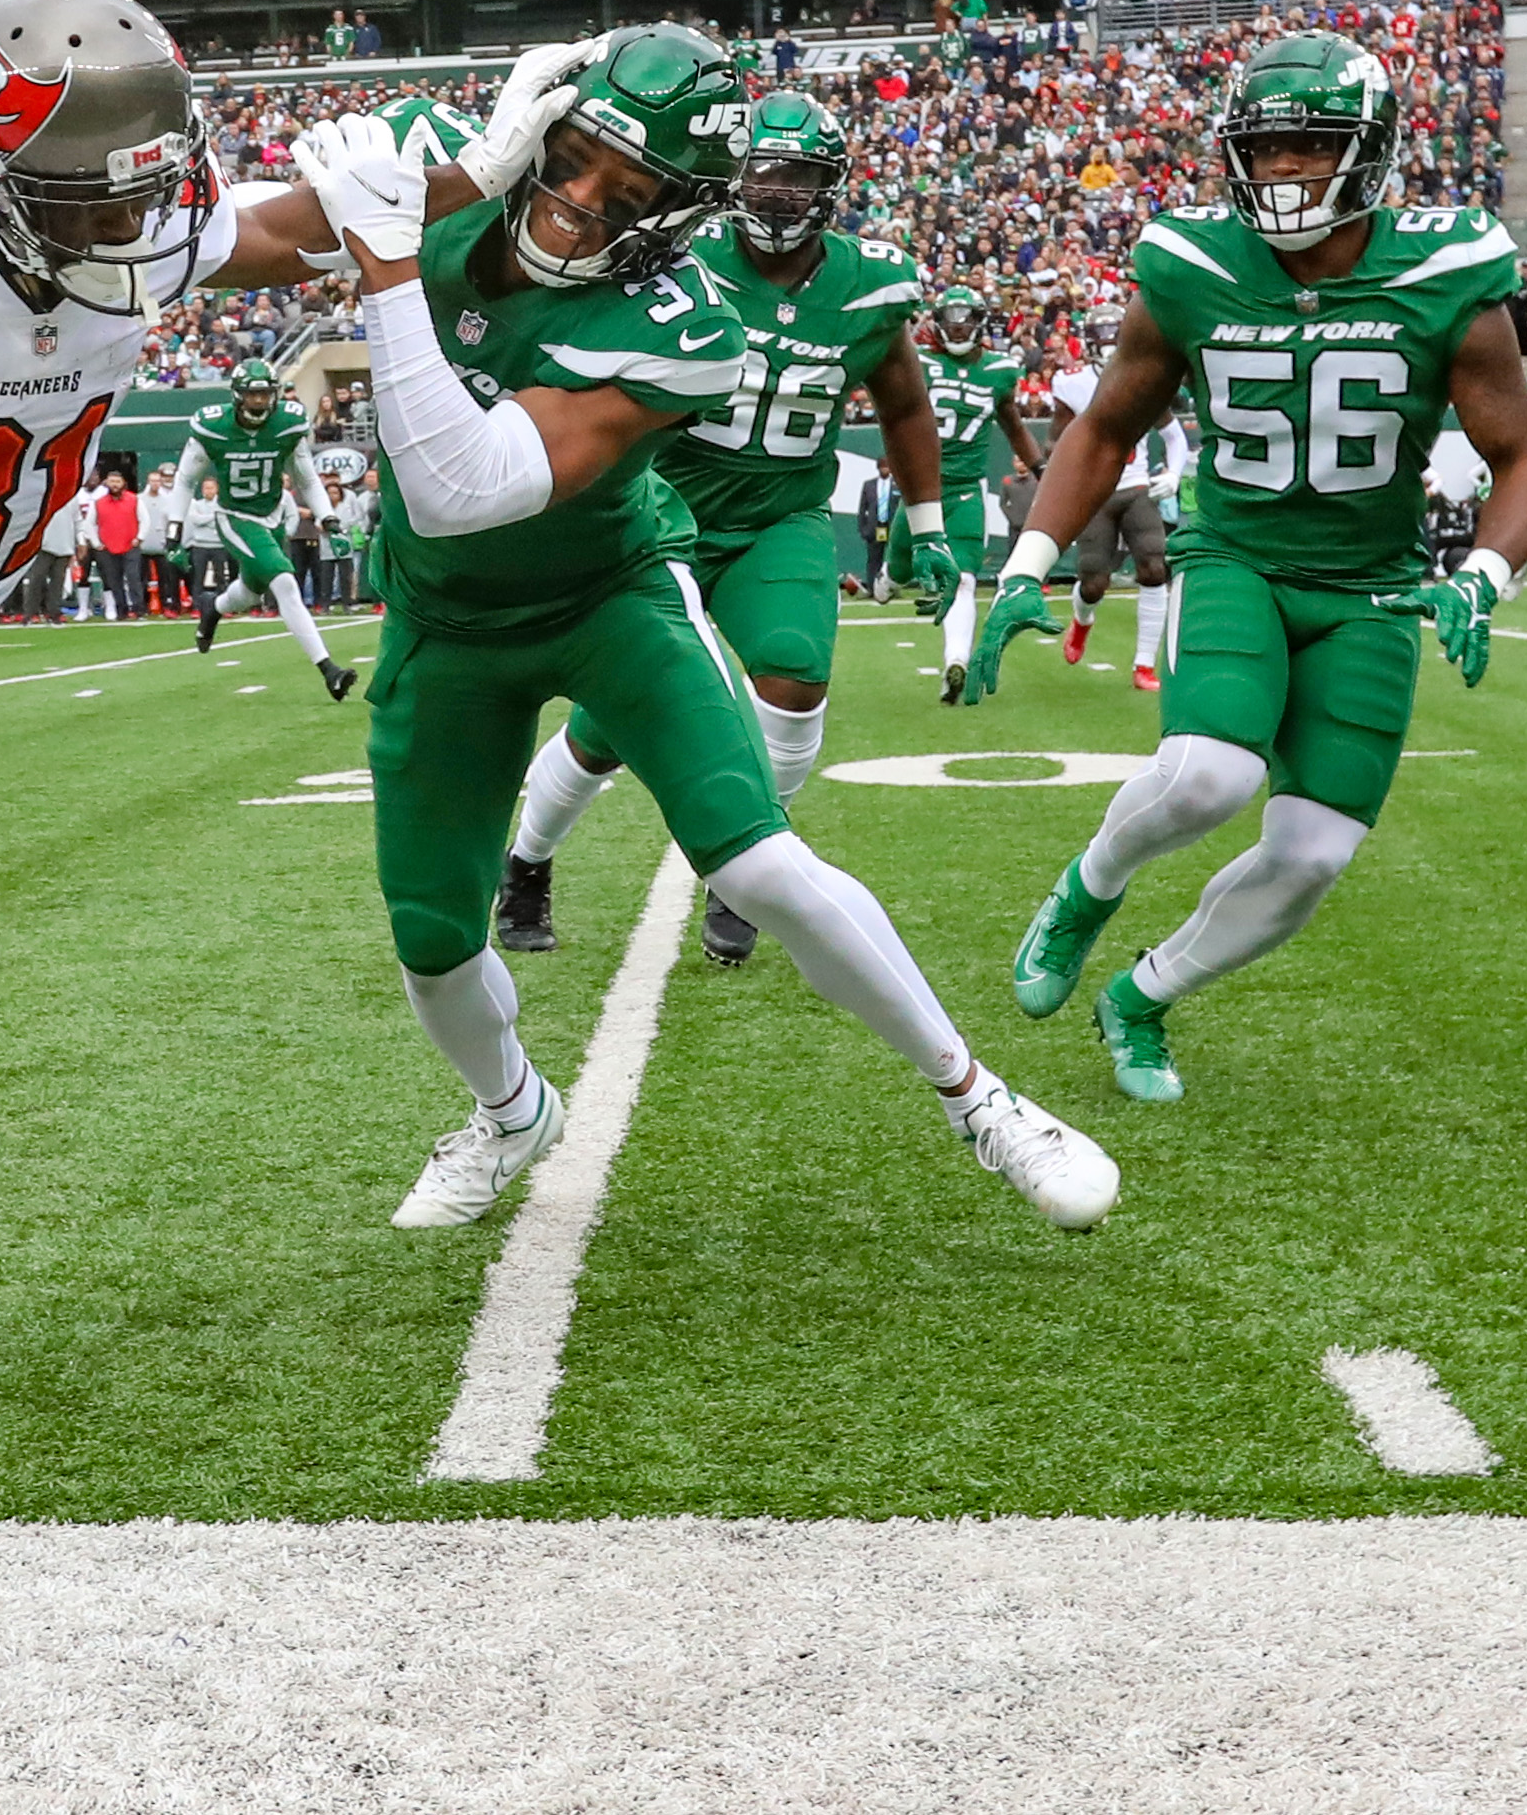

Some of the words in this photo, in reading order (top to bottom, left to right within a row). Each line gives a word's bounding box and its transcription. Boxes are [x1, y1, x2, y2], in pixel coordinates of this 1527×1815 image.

[36, 336, 56, 353] NFL
[775, 328, 849, 361] YORK
[1212, 322, 1303, 344] NEW
[1301, 321, 1406, 344] YORK
[928, 388, 995, 443] 57
[1199, 348, 1410, 495] 56
[229, 458, 274, 499] 51
[321, 457, 353, 470] FOX
